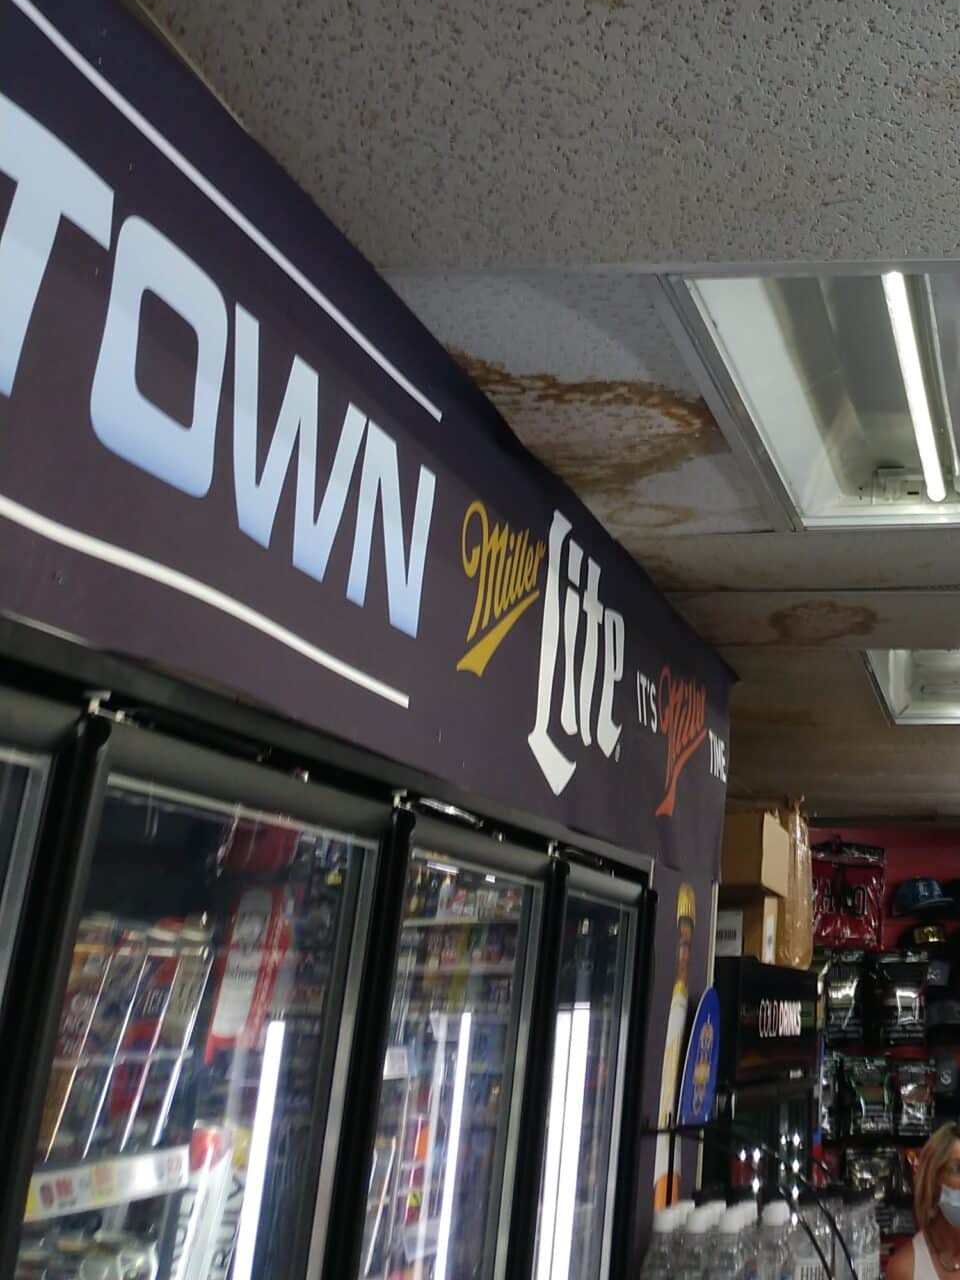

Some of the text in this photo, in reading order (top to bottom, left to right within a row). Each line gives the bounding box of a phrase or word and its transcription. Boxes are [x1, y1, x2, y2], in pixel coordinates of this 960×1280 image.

[0, 96, 436, 639] TOWN
[460, 500, 545, 650] Miller
[528, 509, 625, 797] Lite
[637, 671, 658, 733] IT'S
[709, 729, 727, 783] TIME
[758, 998, 778, 1039] COLD
